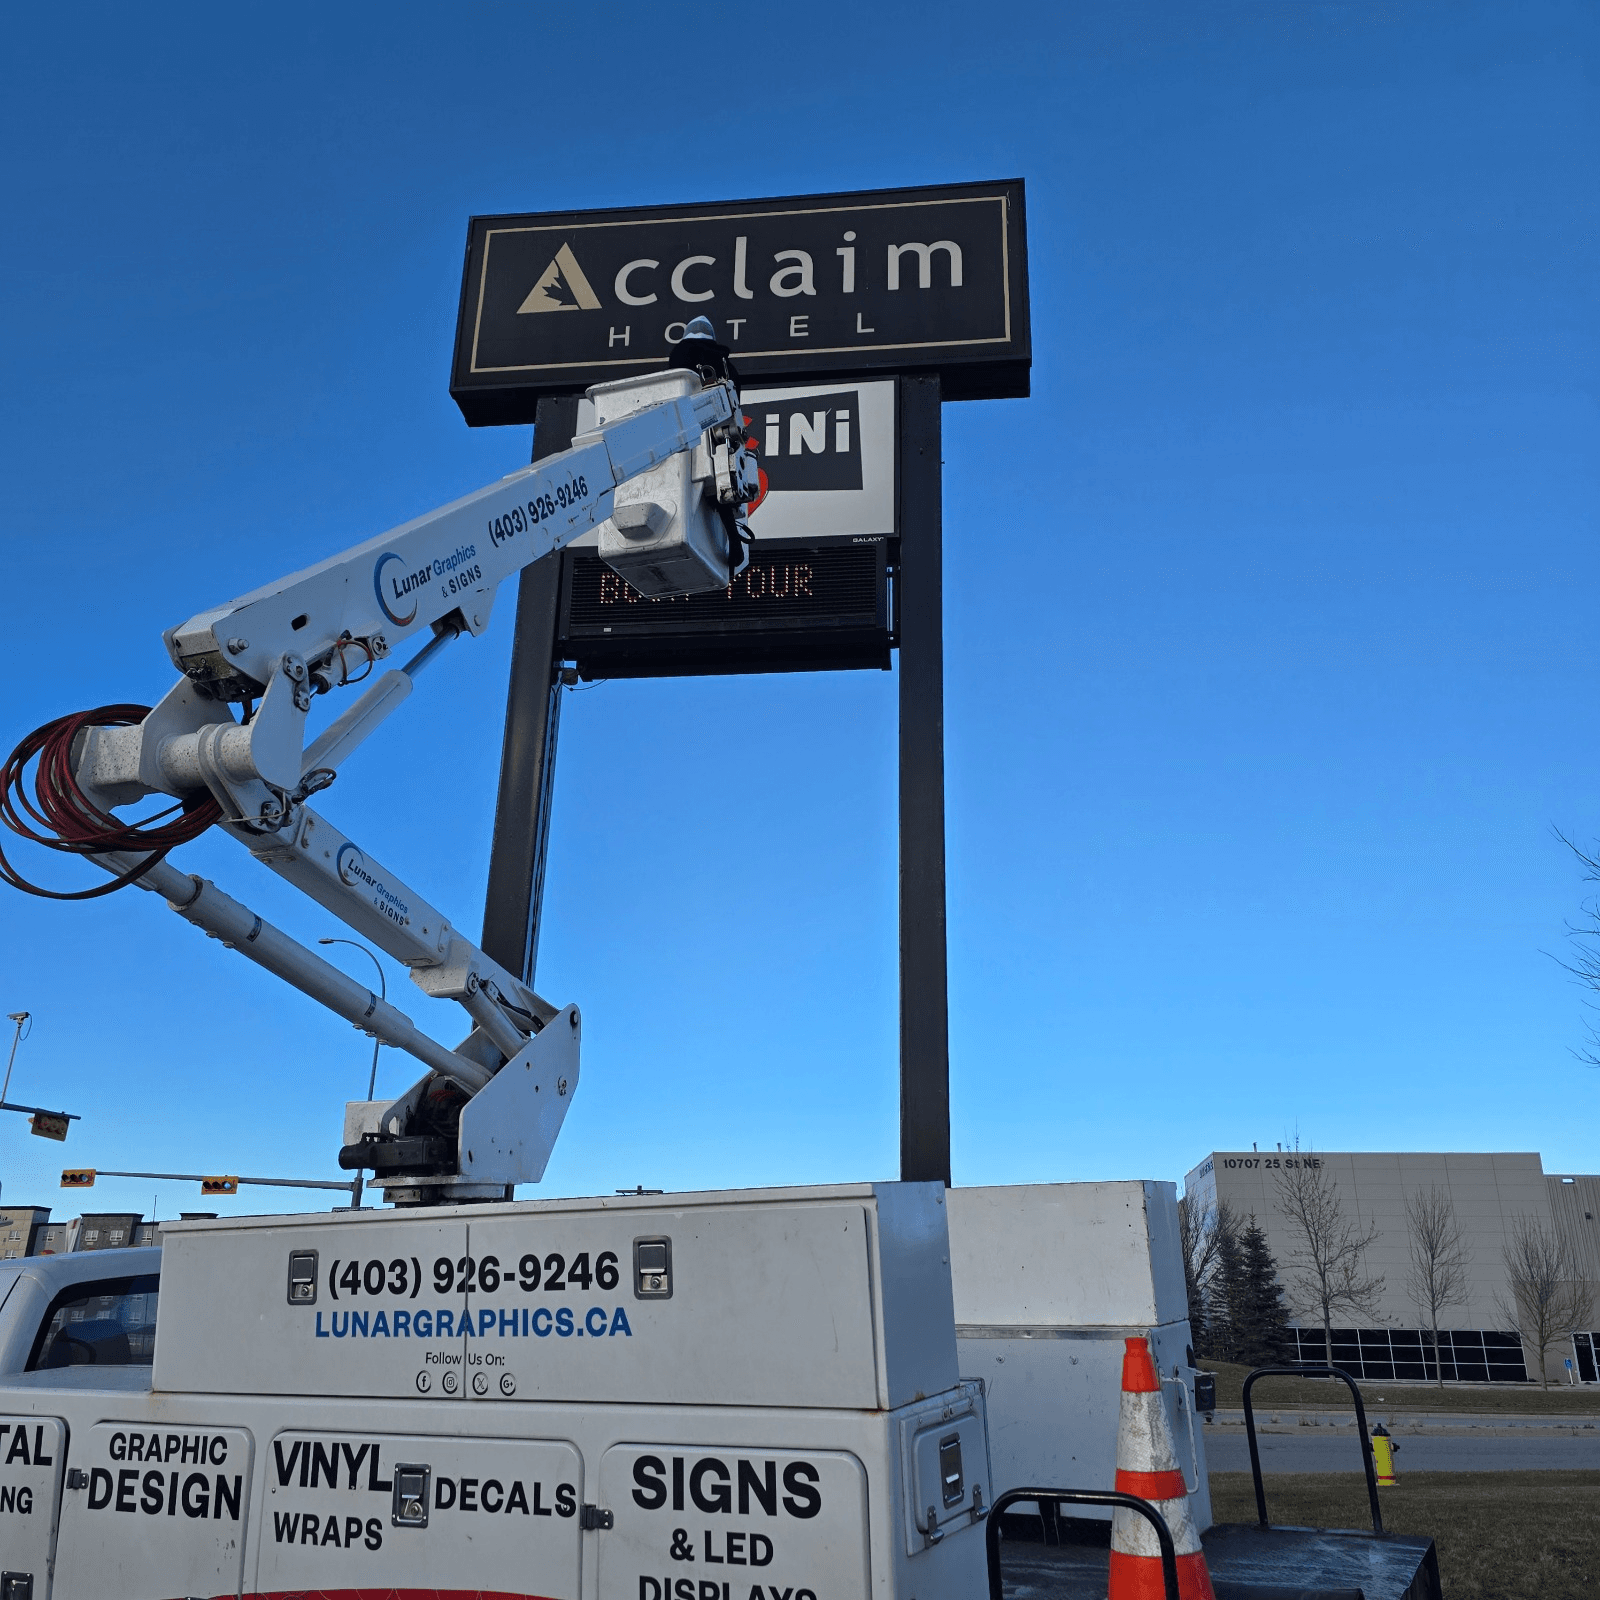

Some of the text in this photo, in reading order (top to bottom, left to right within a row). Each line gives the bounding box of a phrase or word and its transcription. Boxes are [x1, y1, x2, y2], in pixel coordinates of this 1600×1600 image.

[516, 230, 964, 314] Acclaim
[608, 312, 875, 347] HOTEL
[743, 409, 850, 457] iNi
[488, 475, 588, 548] (403) 926-9246
[392, 545, 476, 600] Lunar Graphics
[442, 565, 482, 598] & SIGNS
[347, 859, 408, 914] Lunar Graphics
[379, 901, 405, 926] SIGNS
[1223, 1158, 1260, 1169] 10707
[1264, 1158, 1280, 1169] 25
[1285, 1159, 1300, 1169] St
[328, 1251, 620, 1300] (403) 926-9246
[315, 1307, 633, 1338] LUNARGRAPHICS.CA
[425, 1352, 505, 1366] Follow Us On:
[109, 1432, 228, 1466] GRAPHIC
[273, 1440, 393, 1492] VINYL
[87, 1467, 243, 1521] DESIGN
[434, 1476, 577, 1518] DECALS
[631, 1455, 822, 1519] SIGNS
[273, 1511, 383, 1551] WRAPS
[669, 1528, 774, 1567] & LED
